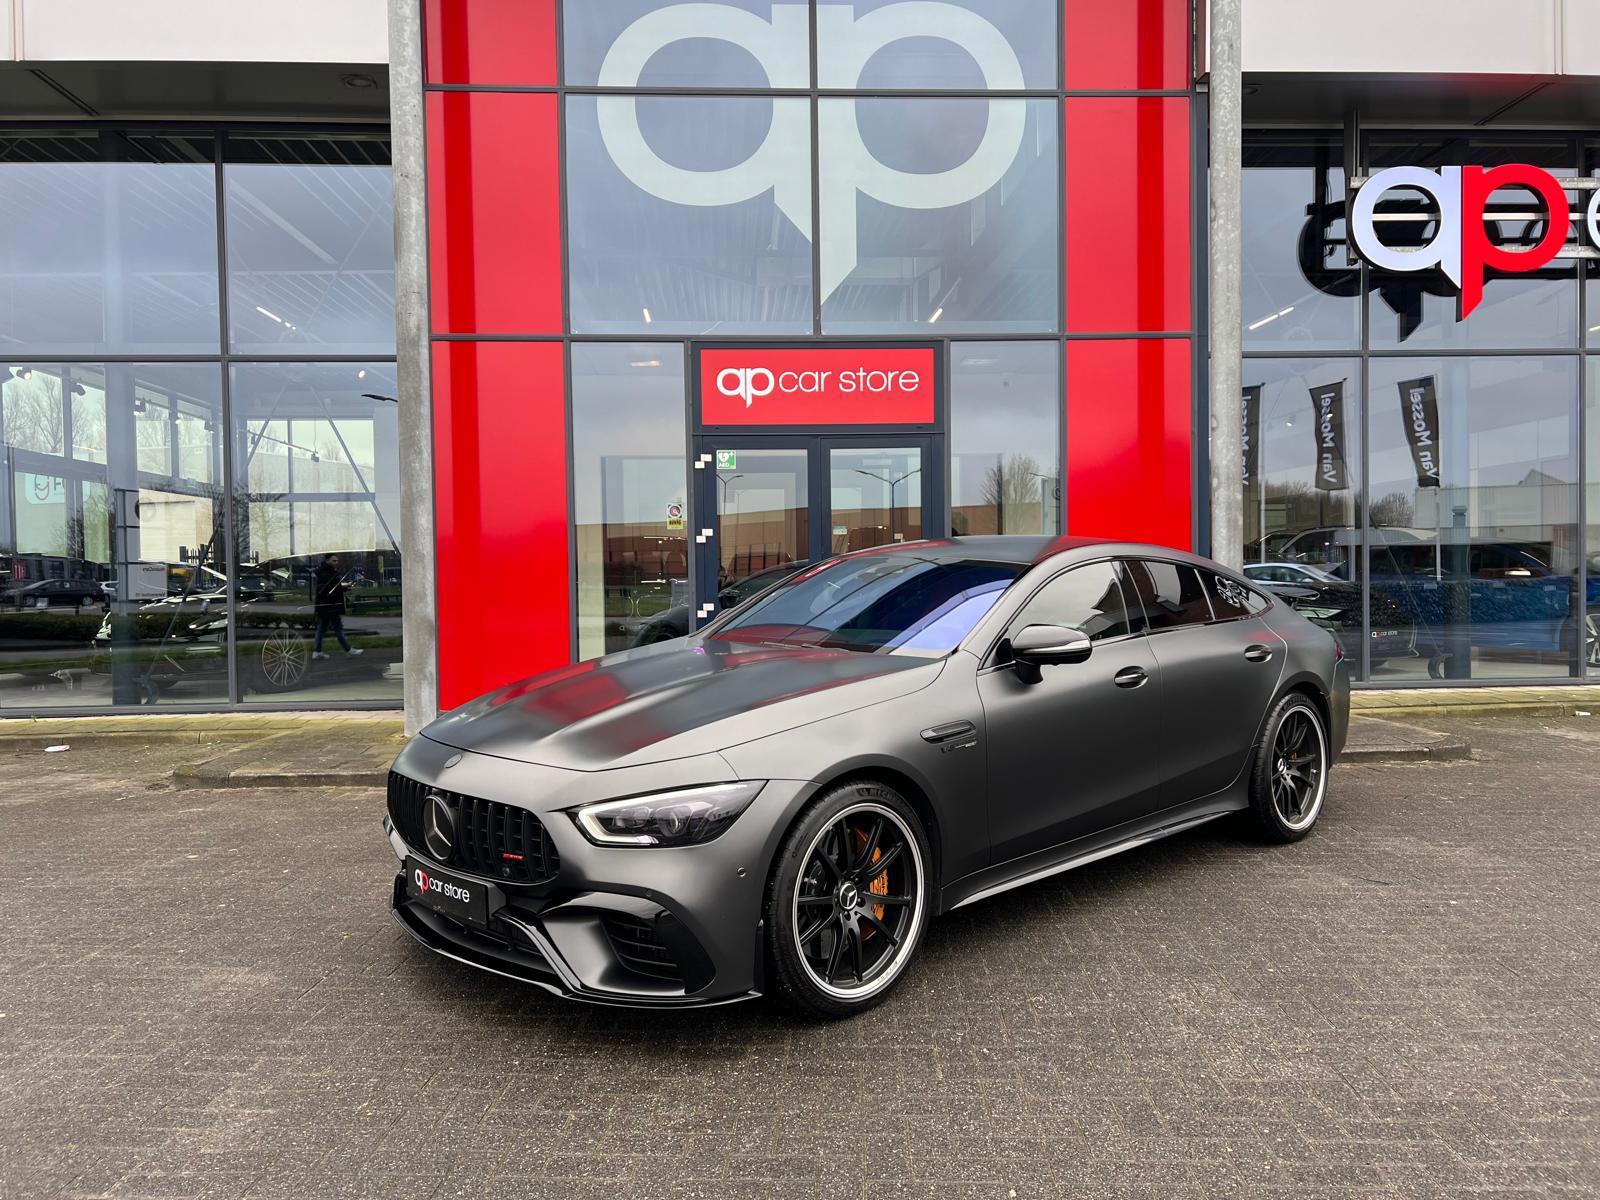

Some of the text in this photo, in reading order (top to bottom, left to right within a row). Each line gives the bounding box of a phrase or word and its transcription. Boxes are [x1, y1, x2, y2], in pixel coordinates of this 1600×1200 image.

[596, 1, 1026, 306] ap
[1352, 163, 1569, 320] ap
[716, 366, 920, 408] ap car store
[415, 869, 470, 903] ap car store
